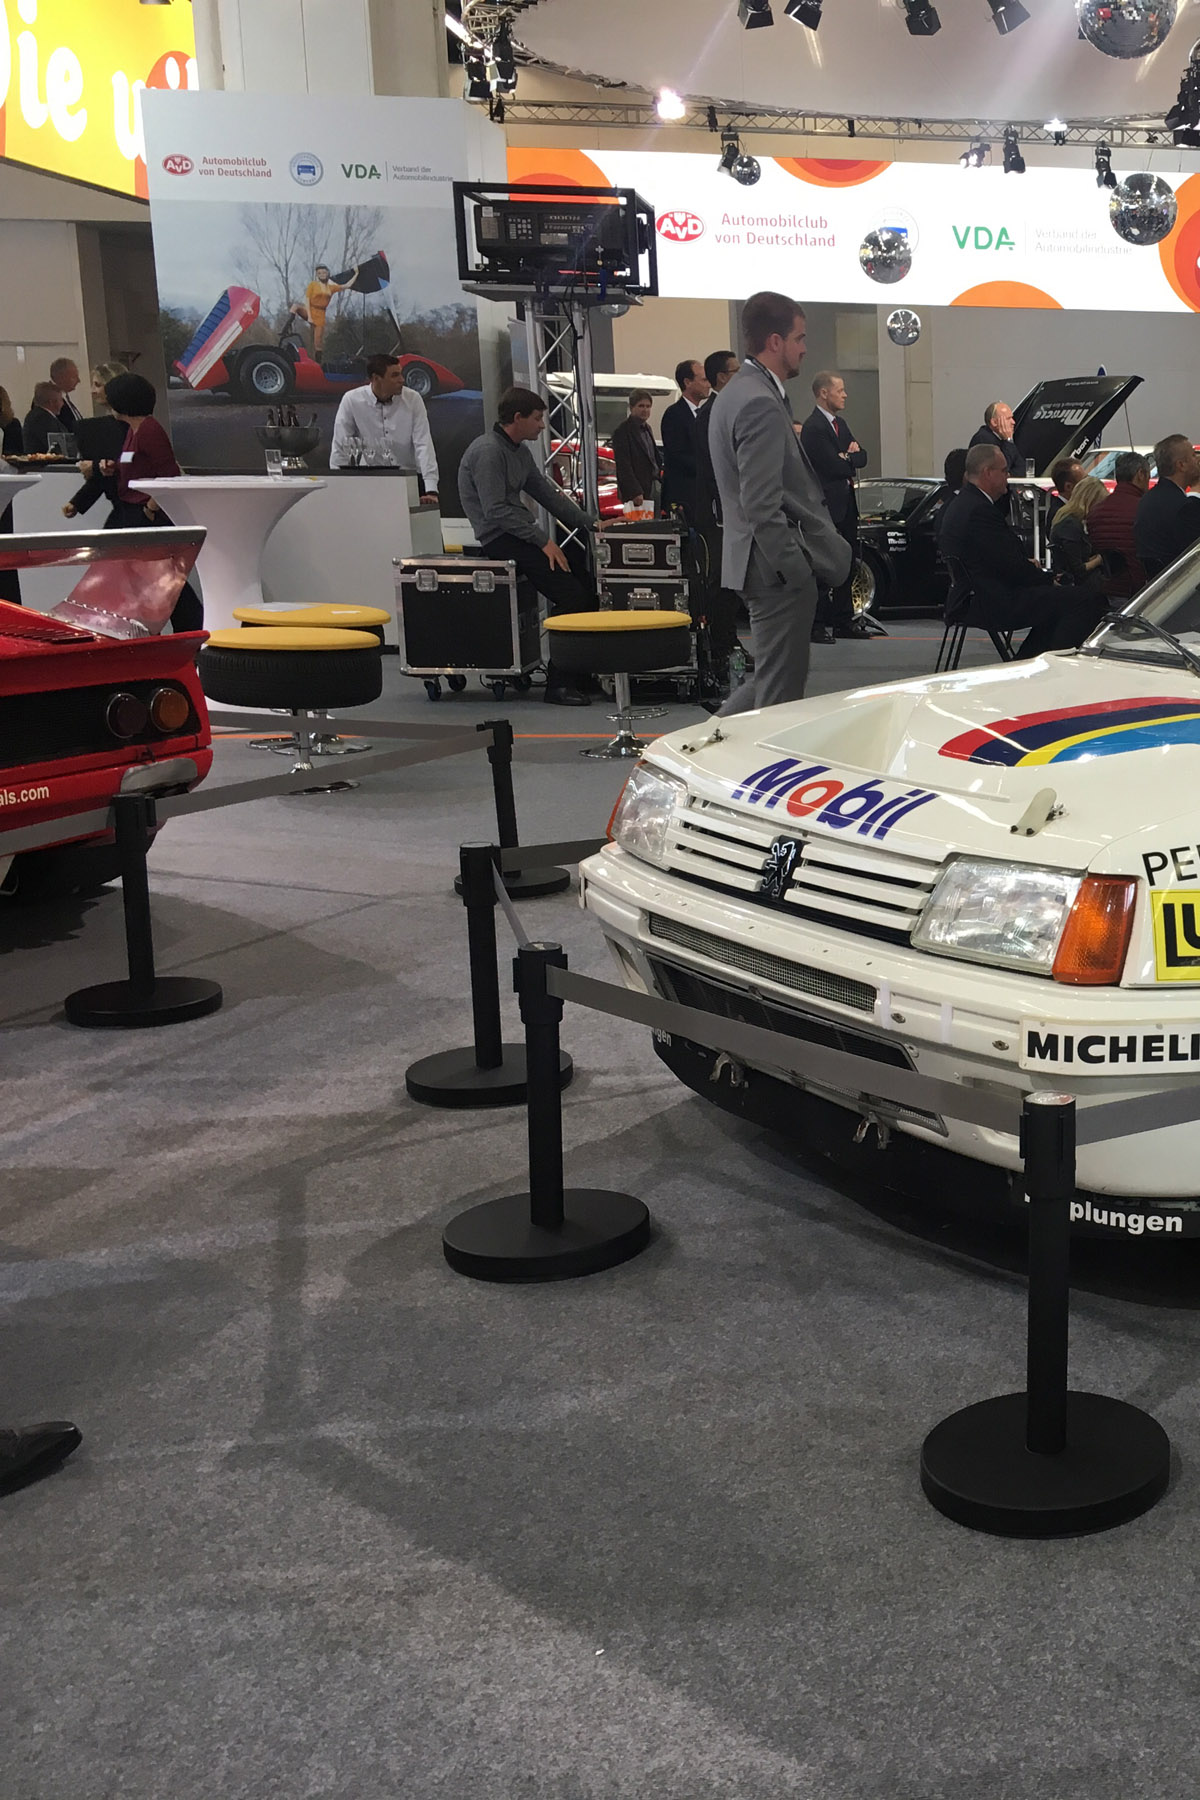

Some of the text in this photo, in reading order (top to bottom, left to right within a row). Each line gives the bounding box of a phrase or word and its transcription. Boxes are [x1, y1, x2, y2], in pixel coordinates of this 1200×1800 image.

[0, 0, 88, 142] ie
[202, 156, 267, 167] Automobilclub
[199, 167, 272, 178] von Deutschland
[341, 163, 382, 179] VDA
[721, 213, 828, 229] Automobilclub
[715, 231, 836, 247] von Deutschland
[952, 225, 1016, 250] VDA
[731, 757, 940, 841] Mobil
[1069, 1201, 1183, 1235] plungen
